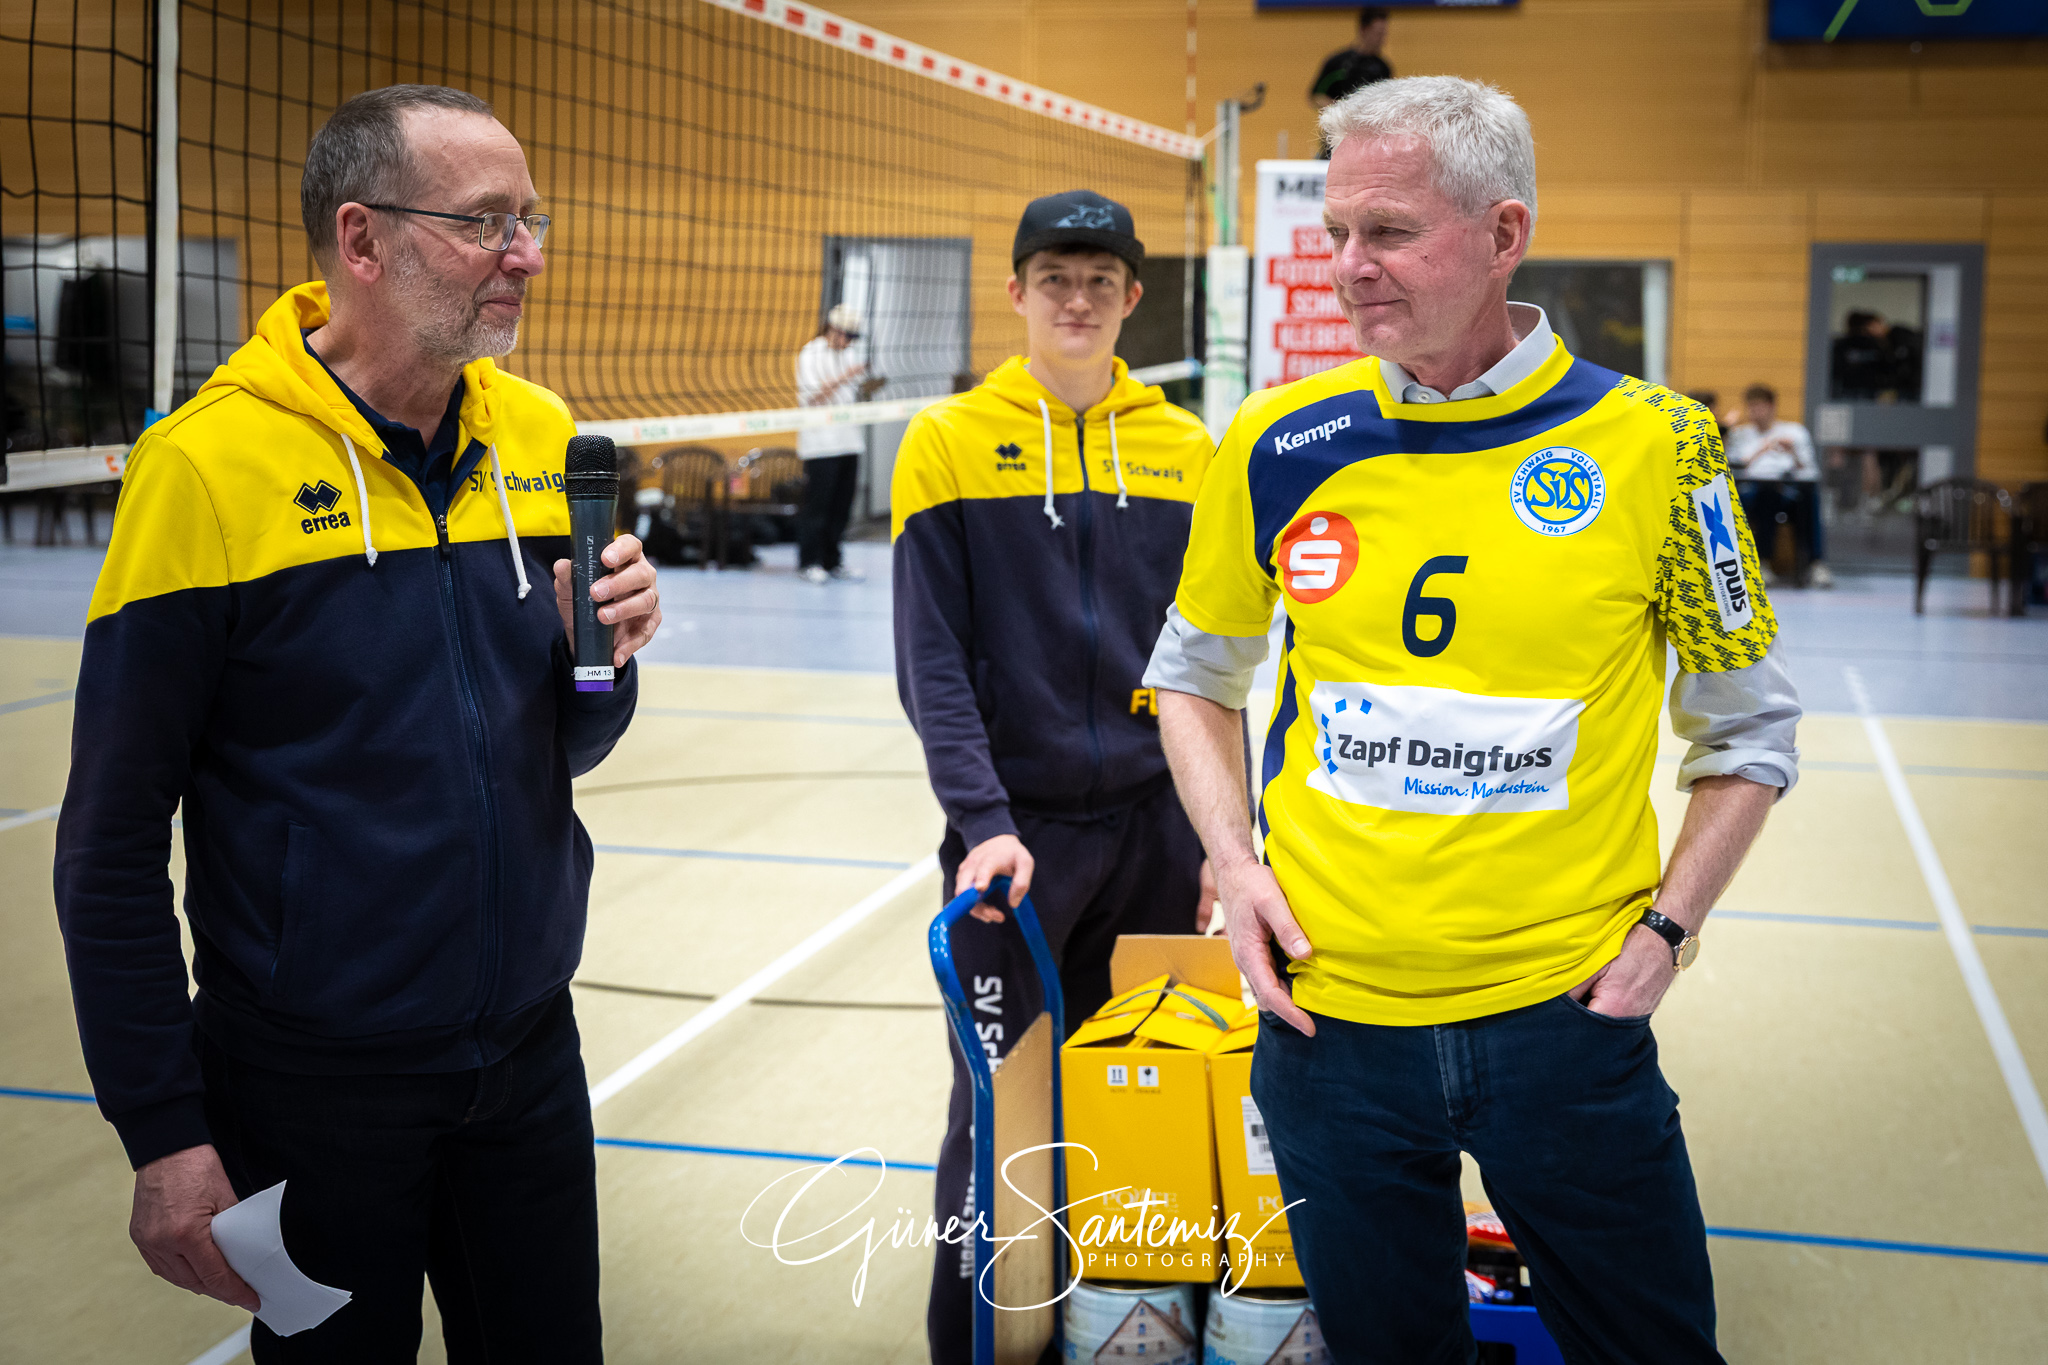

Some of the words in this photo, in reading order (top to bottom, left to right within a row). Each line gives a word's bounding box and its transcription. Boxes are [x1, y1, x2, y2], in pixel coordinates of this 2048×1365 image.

[1274, 414, 1351, 455] Kempa
[469, 471, 487, 492] SV
[1127, 462, 1183, 482] Schwaig
[1515, 451, 1553, 487] SCHWAIG
[1571, 452, 1601, 509] VOLLEYBALL
[1514, 491, 1522, 503] SV
[301, 512, 351, 534] errea
[1542, 525, 1566, 533] 1967
[1714, 559, 1747, 612] puls
[1402, 555, 1469, 658] 6
[603, 669, 612, 677] 13
[1338, 734, 1401, 767] Zapf
[1407, 739, 1552, 777] Daigfuss
[1404, 776, 1469, 797] Mission:
[974, 975, 1003, 1016] SV
